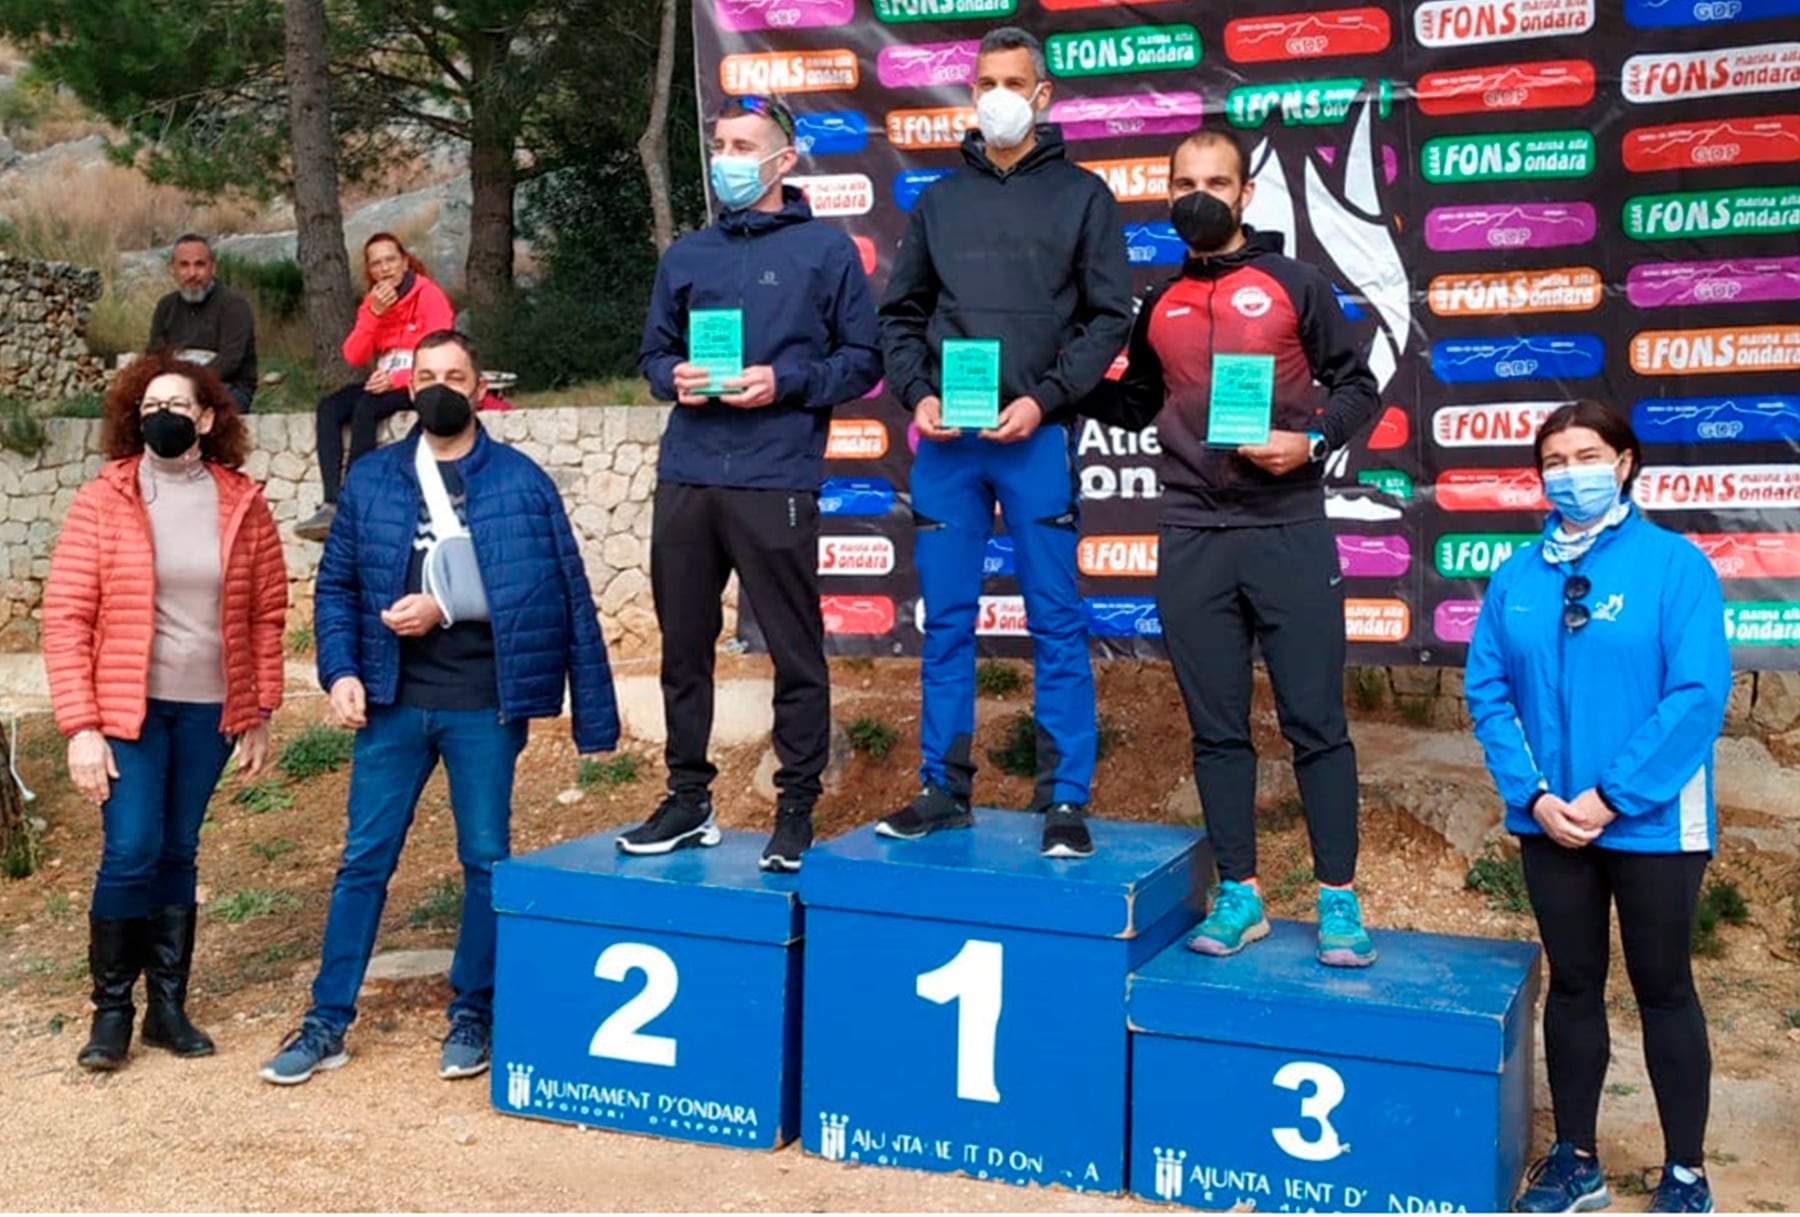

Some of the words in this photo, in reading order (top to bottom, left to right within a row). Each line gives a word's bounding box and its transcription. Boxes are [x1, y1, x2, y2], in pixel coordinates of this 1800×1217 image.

[1437, 3, 1517, 40] FONS
[1520, 9, 1587, 34] ondara
[1693, 1, 1742, 21] GDP
[1066, 37, 1134, 69] FONS
[1137, 45, 1194, 64] ondara
[739, 57, 804, 89] FONS
[1644, 57, 1730, 95] FONS
[1733, 65, 1800, 86] ondara
[1444, 142, 1522, 176] FONS
[1524, 152, 1587, 172] ondara
[1094, 165, 1146, 196] NS
[815, 194, 866, 210] ondara
[1647, 199, 1730, 233] FONS
[1733, 209, 1800, 228] ondara
[1450, 278, 1528, 309] FONS
[1651, 334, 1735, 369] FONS
[1455, 410, 1531, 440] FONS
[1656, 473, 1736, 503] FONS
[838, 552, 887, 569] ondara
[1456, 541, 1524, 571] FON
[589, 942, 680, 1067] 2
[915, 940, 1003, 1103] 1
[534, 1078, 650, 1110] AJUNTAMENT
[658, 1095, 758, 1126] D'ONDARA
[1271, 1061, 1346, 1161] 3
